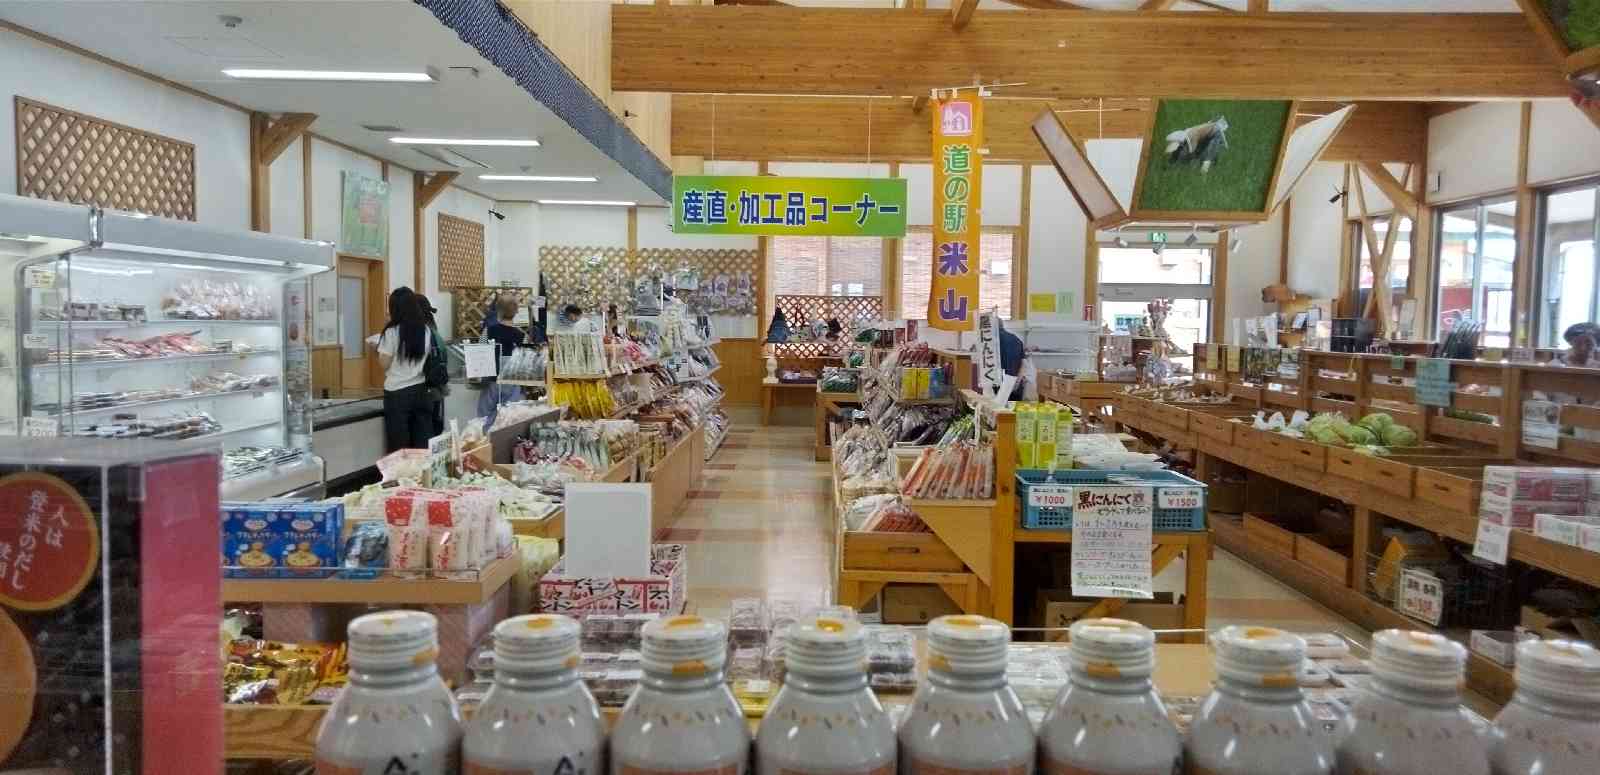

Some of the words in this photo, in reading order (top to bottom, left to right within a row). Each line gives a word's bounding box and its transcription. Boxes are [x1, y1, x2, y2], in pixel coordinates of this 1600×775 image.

[682, 189, 900, 226] 産直・加工品コーナー
[943, 145, 971, 233] 道の駅
[938, 242, 969, 322] 米山
[1077, 490, 1132, 510] 黒にんにく
